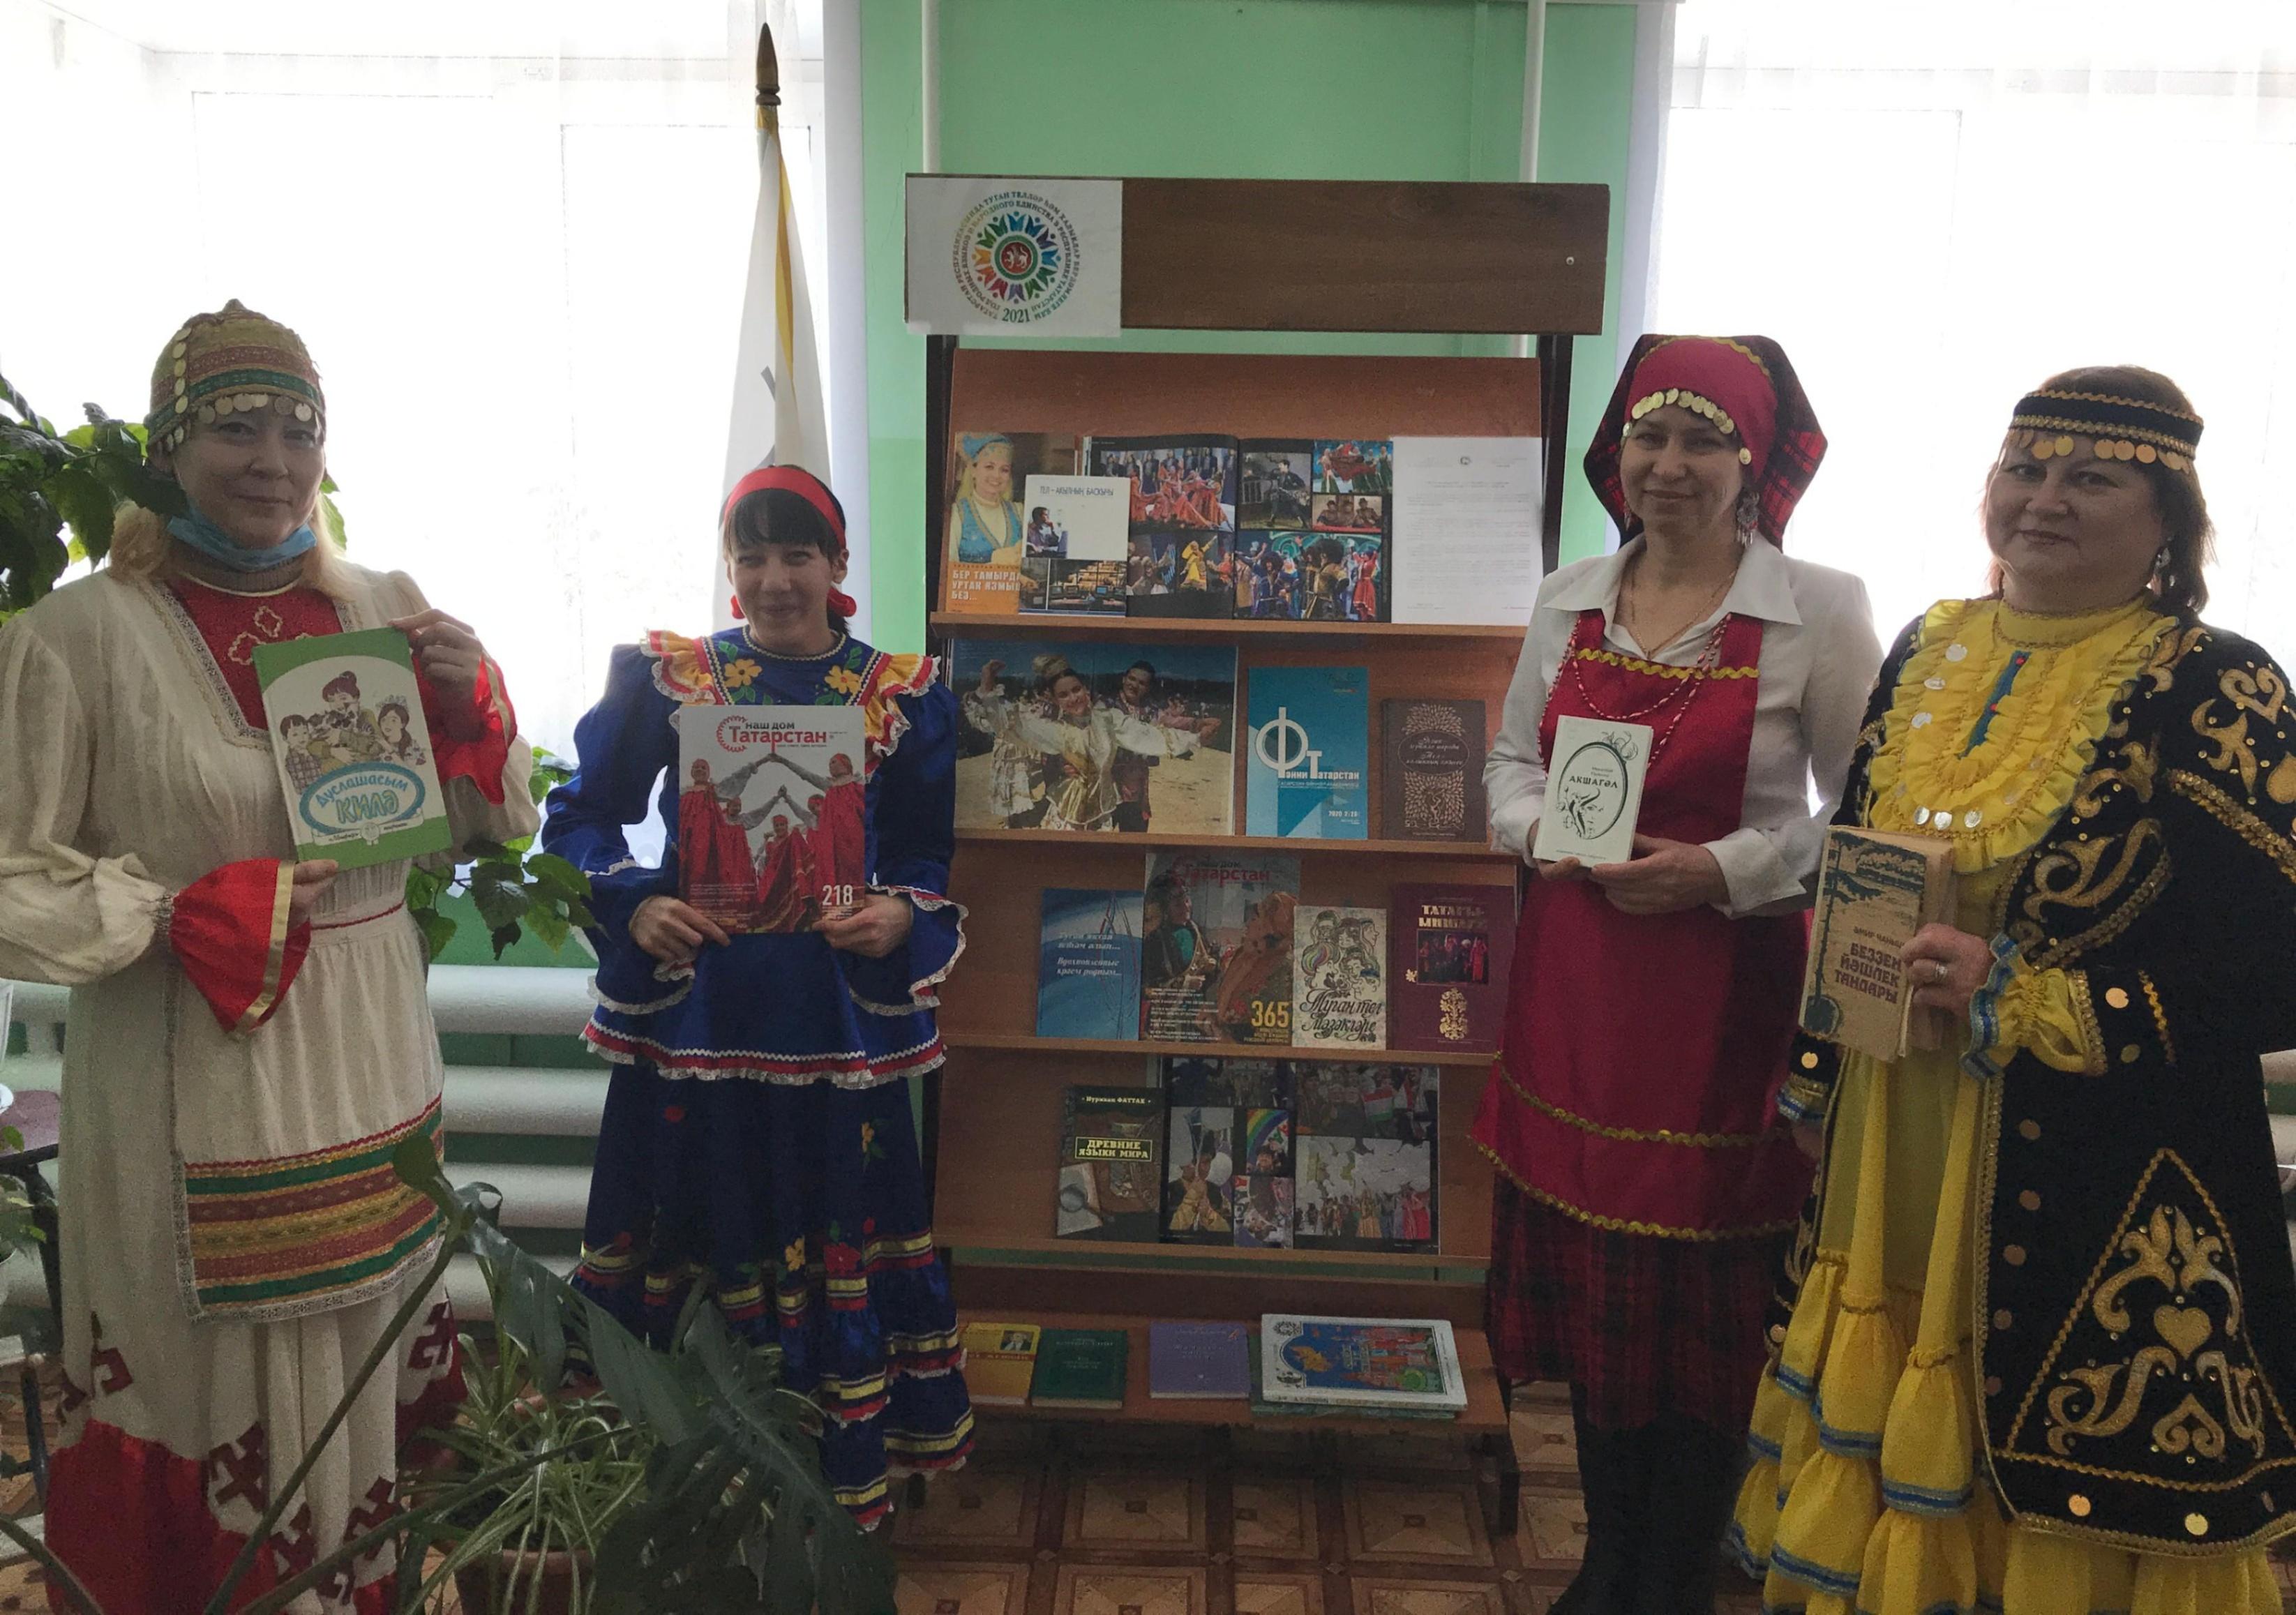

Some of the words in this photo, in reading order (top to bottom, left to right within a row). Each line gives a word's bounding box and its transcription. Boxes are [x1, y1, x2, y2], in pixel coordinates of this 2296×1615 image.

[983, 192, 1010, 206] ТУГАН
[984, 299, 1000, 310] ГОД
[1002, 308, 1030, 323] 2021
[953, 570, 970, 579] БЕР
[952, 580, 982, 590] УРТАК
[772, 722, 795, 730] дом
[728, 726, 827, 753] Татарстан
[822, 884, 853, 906] 218
[1251, 1000, 1289, 1028] 365
[1088, 1139, 1141, 1150] ДРЕВНИЕ
[1079, 1148, 1116, 1157] ЯЗЫКИ
[1119, 1150, 1148, 1159] МИРА
